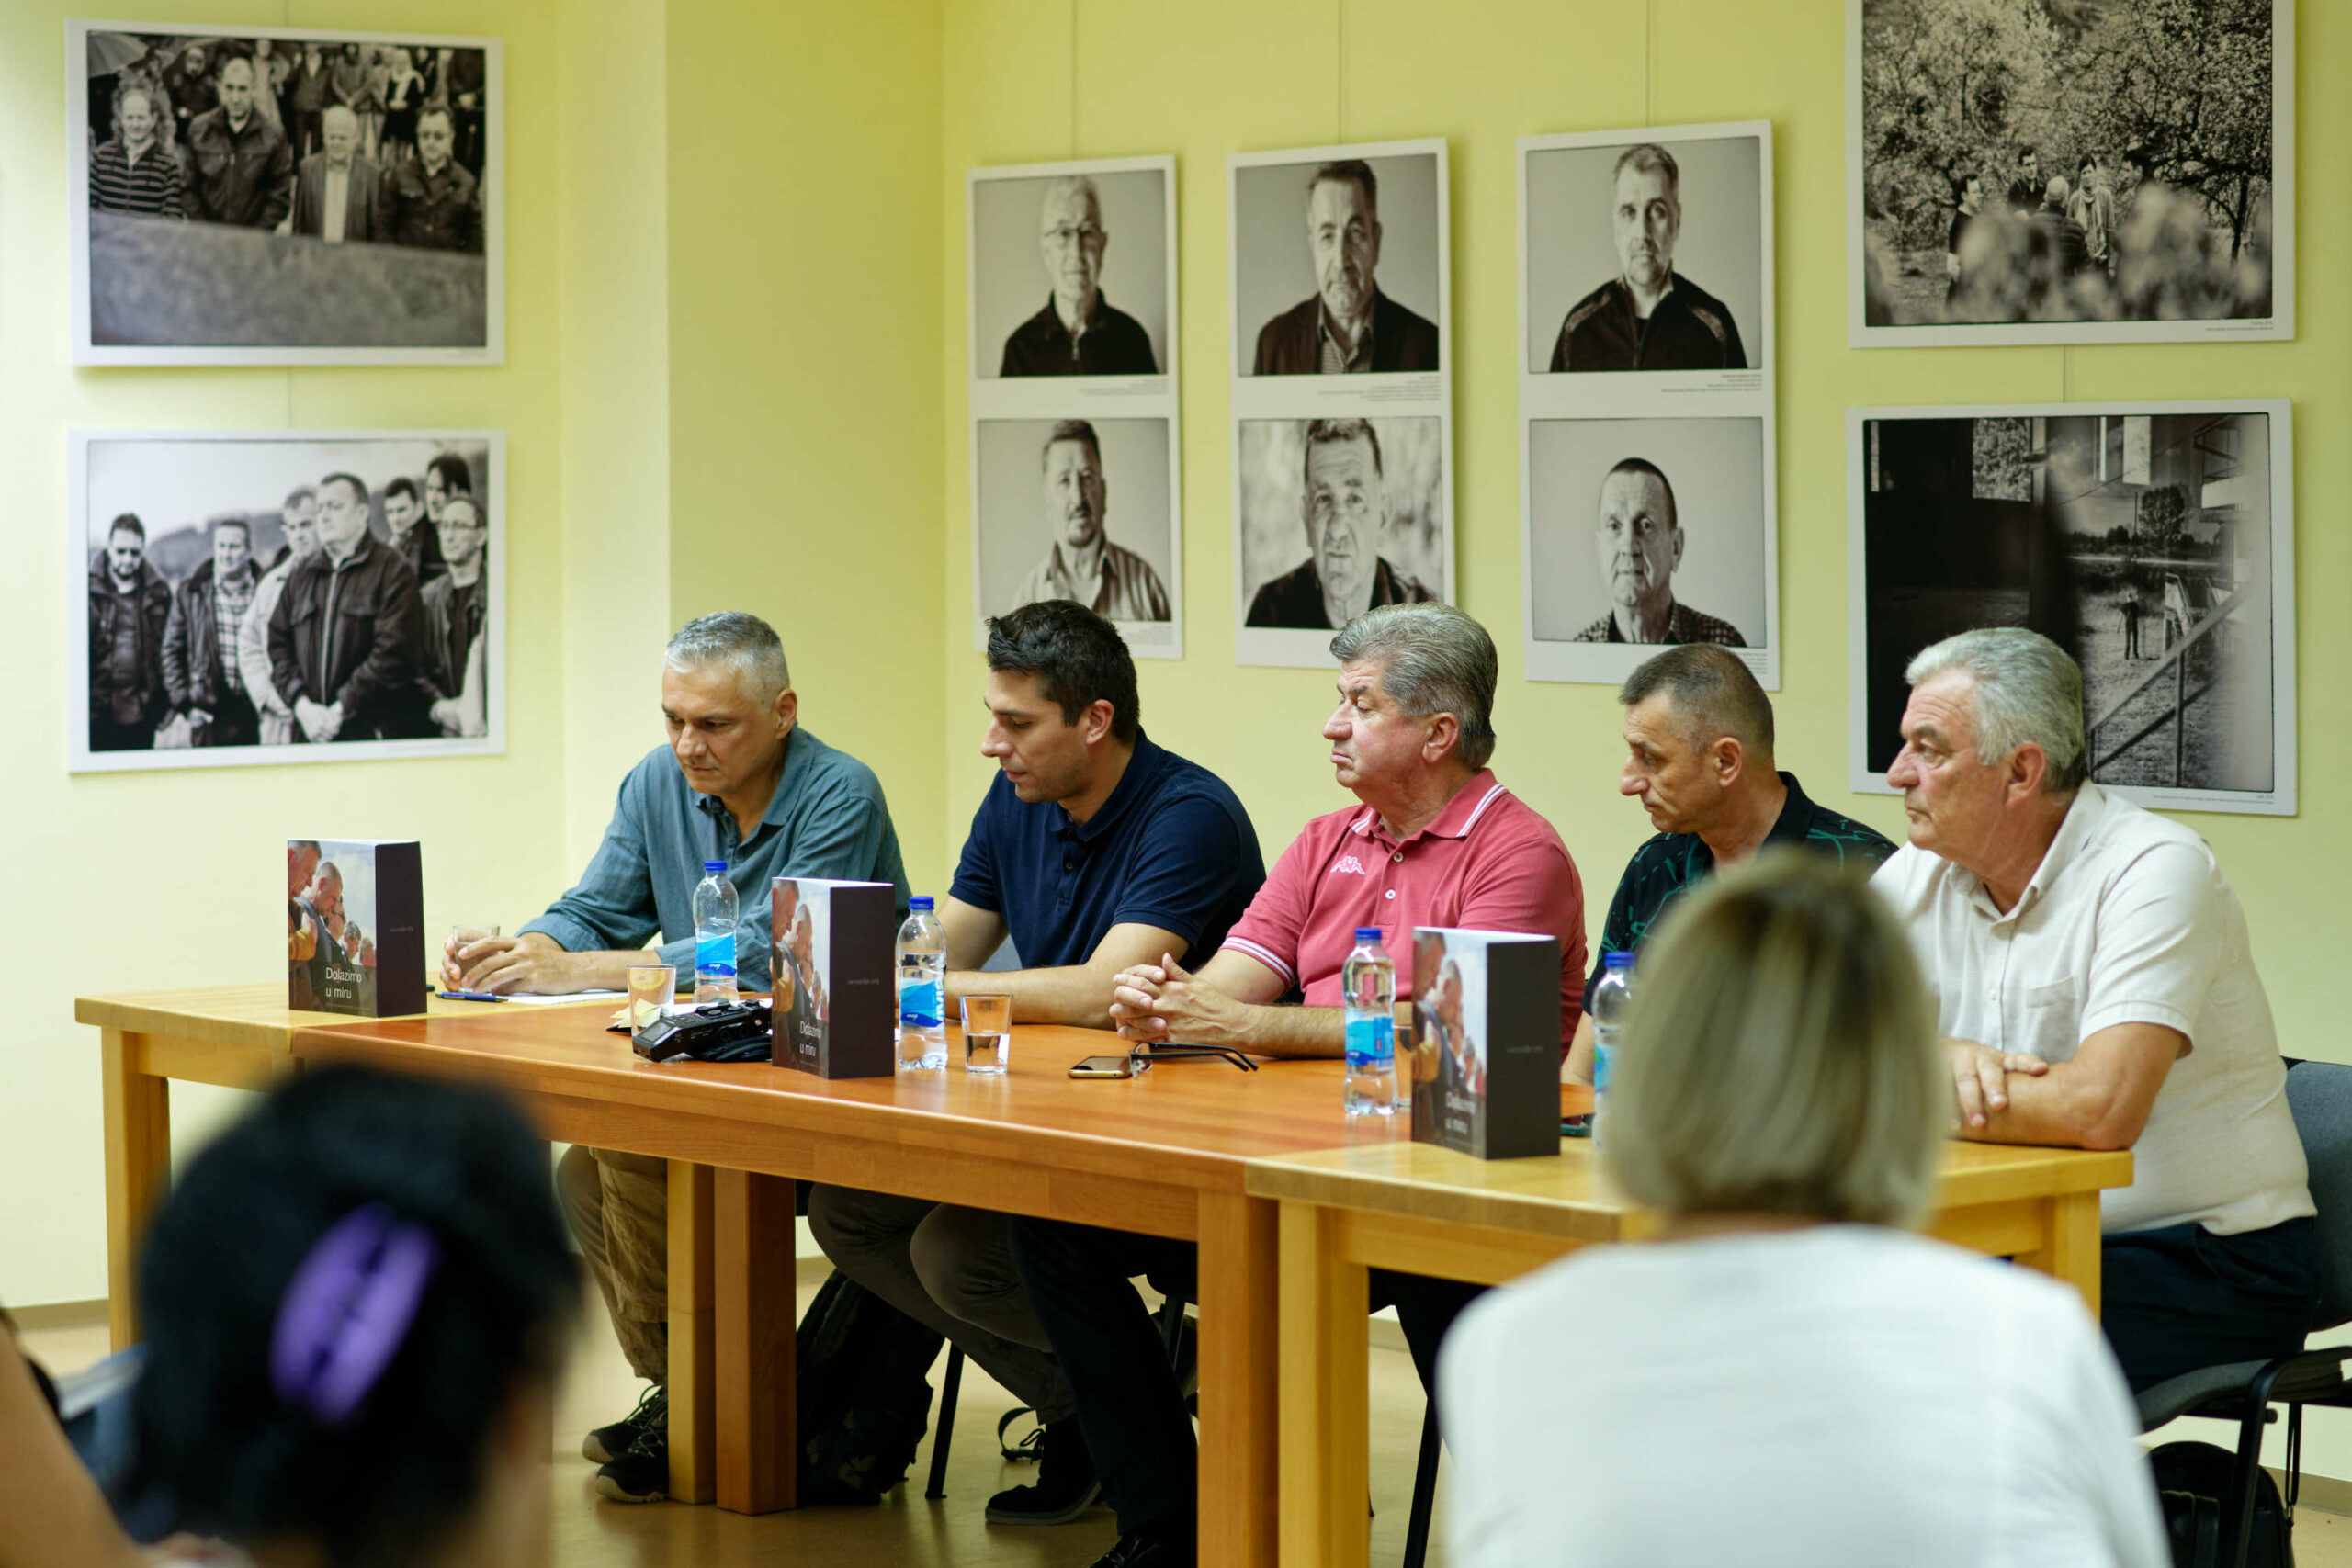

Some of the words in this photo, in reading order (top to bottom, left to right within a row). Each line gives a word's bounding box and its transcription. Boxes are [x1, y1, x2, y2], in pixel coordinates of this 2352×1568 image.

[325, 967, 362, 983] Dolazimo
[326, 987, 332, 998] u
[334, 987, 352, 999] miru
